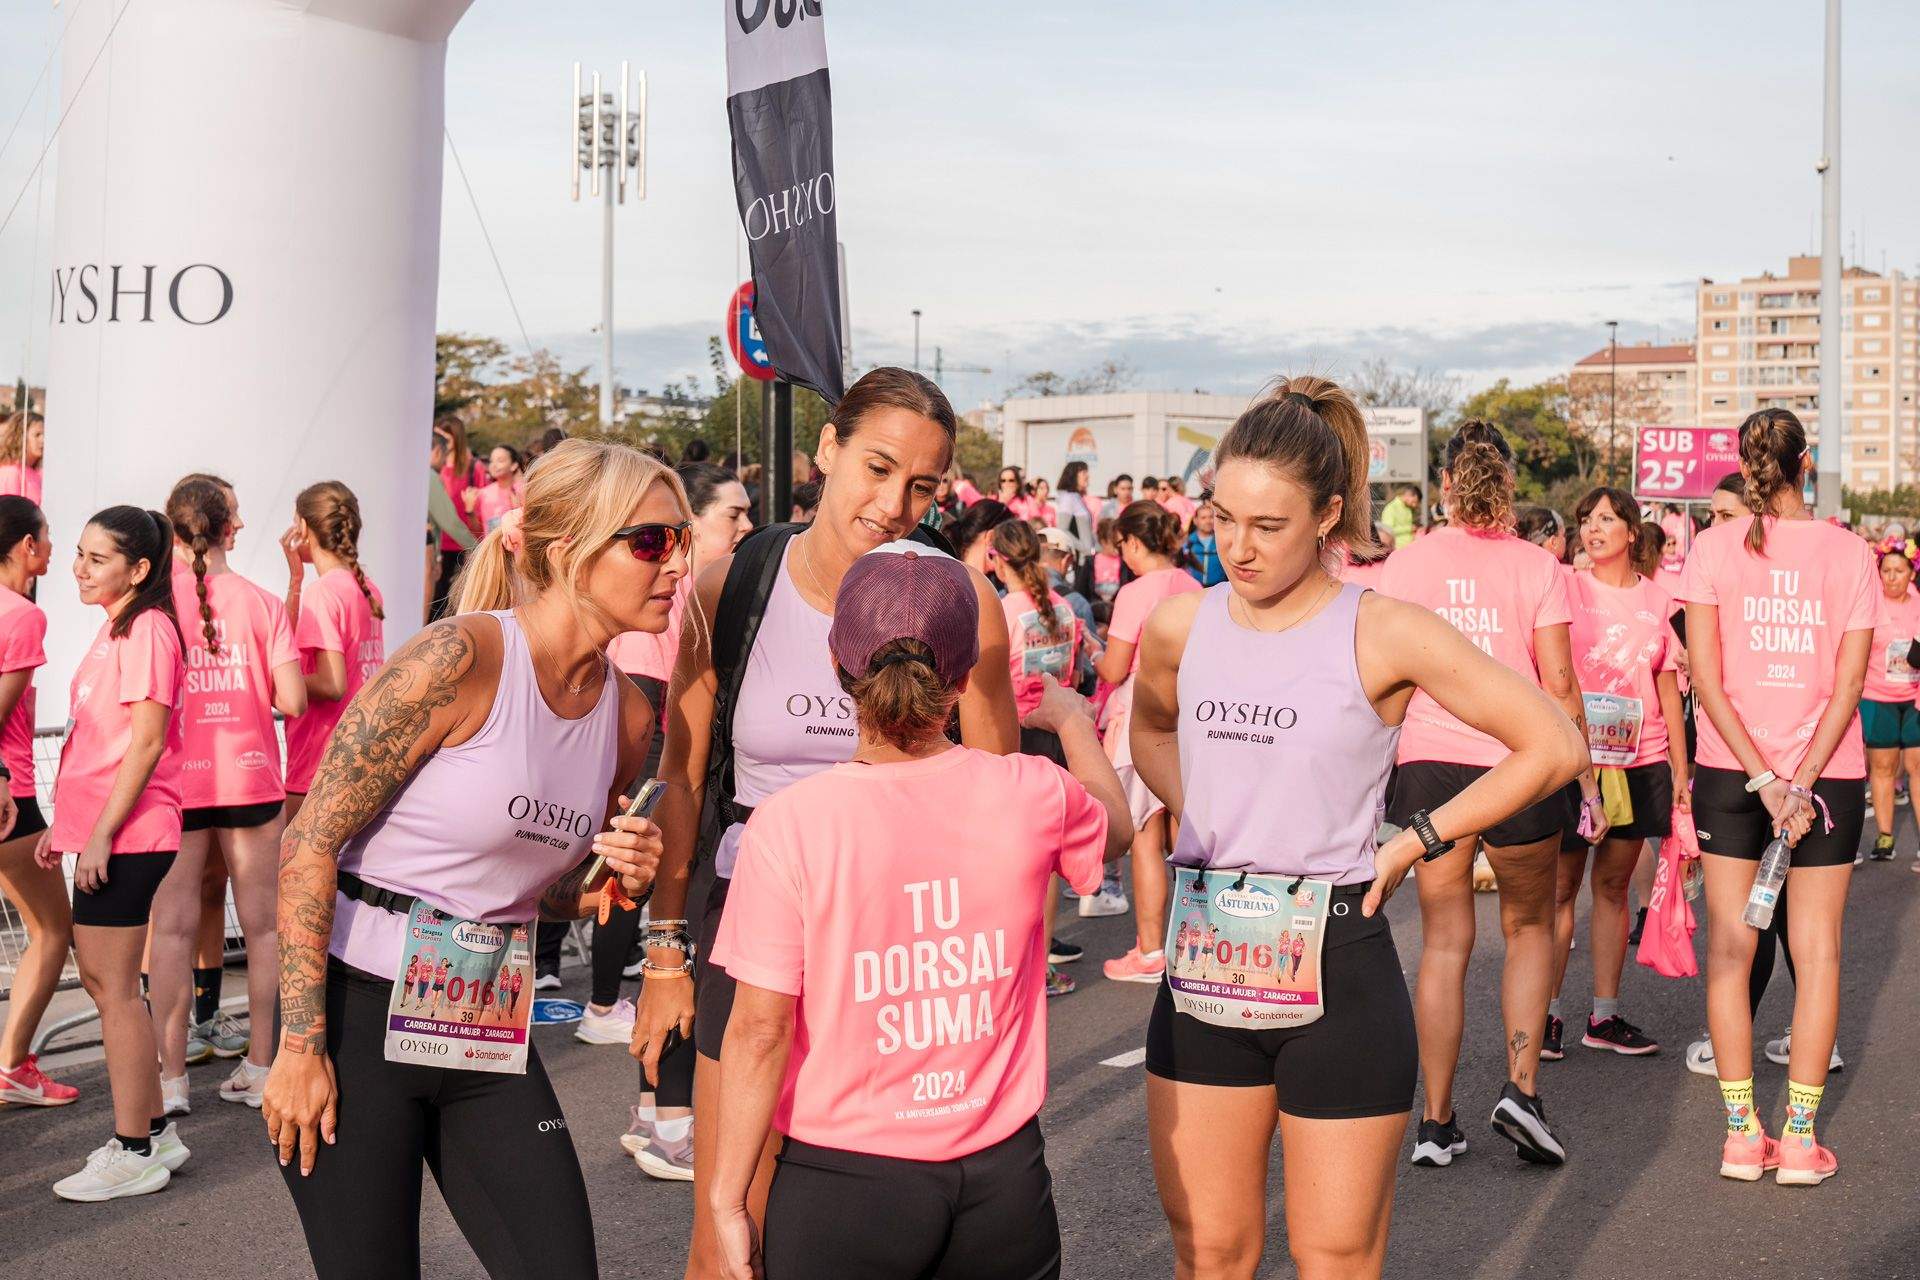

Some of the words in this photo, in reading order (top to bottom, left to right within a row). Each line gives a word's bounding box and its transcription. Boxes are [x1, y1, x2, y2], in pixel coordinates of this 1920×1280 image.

[50, 263, 234, 326] YSHO
[1643, 430, 1694, 453] SUB
[1446, 579, 1476, 605] TU
[1769, 569, 1800, 596] TU
[1434, 607, 1504, 634] RSAL
[1743, 596, 1827, 626] DORSAL
[1750, 625, 1816, 655] SUMA
[187, 642, 252, 669] ORSAL
[187, 668, 246, 694] SUMA
[1767, 663, 1796, 679] 2024
[204, 702, 230, 717] 2024
[786, 693, 851, 720] OYS
[1196, 700, 1298, 729] OYSHO
[805, 725, 855, 737] RUNNING
[1207, 730, 1248, 742] RUNNING
[1250, 733, 1275, 745] CLUB
[508, 795, 592, 838] OYSHO
[515, 829, 551, 844] RUNNING
[549, 838, 570, 851] CLUB
[903, 877, 961, 934] TU
[1218, 893, 1275, 912] ASTURIANA
[853, 928, 1013, 1003] DORSAL
[1216, 940, 1273, 969] 016
[446, 976, 495, 1006] 016
[1180, 980, 1210, 993] CARRERA
[1211, 984, 1220, 994] DE
[1221, 985, 1231, 995] LA
[1232, 986, 1257, 998] MUJER
[1263, 990, 1302, 1002] ZARAGOZA
[1231, 973, 1245, 985] 30
[460, 1011, 474, 1024] 39
[1183, 997, 1224, 1016] OYSHO
[1253, 1010, 1304, 1020] Santander
[404, 1019, 437, 1032] CARRERA
[438, 1023, 448, 1033] DE
[449, 1024, 458, 1034] LA
[459, 1026, 481, 1037] MUJER
[485, 1028, 515, 1040] ZARAGOZA
[876, 989, 995, 1056] SUMA
[400, 1038, 449, 1056] OYSHO
[475, 1049, 513, 1061] Santander
[911, 1069, 967, 1102] 2024
[538, 1118, 567, 1132] OYSH
